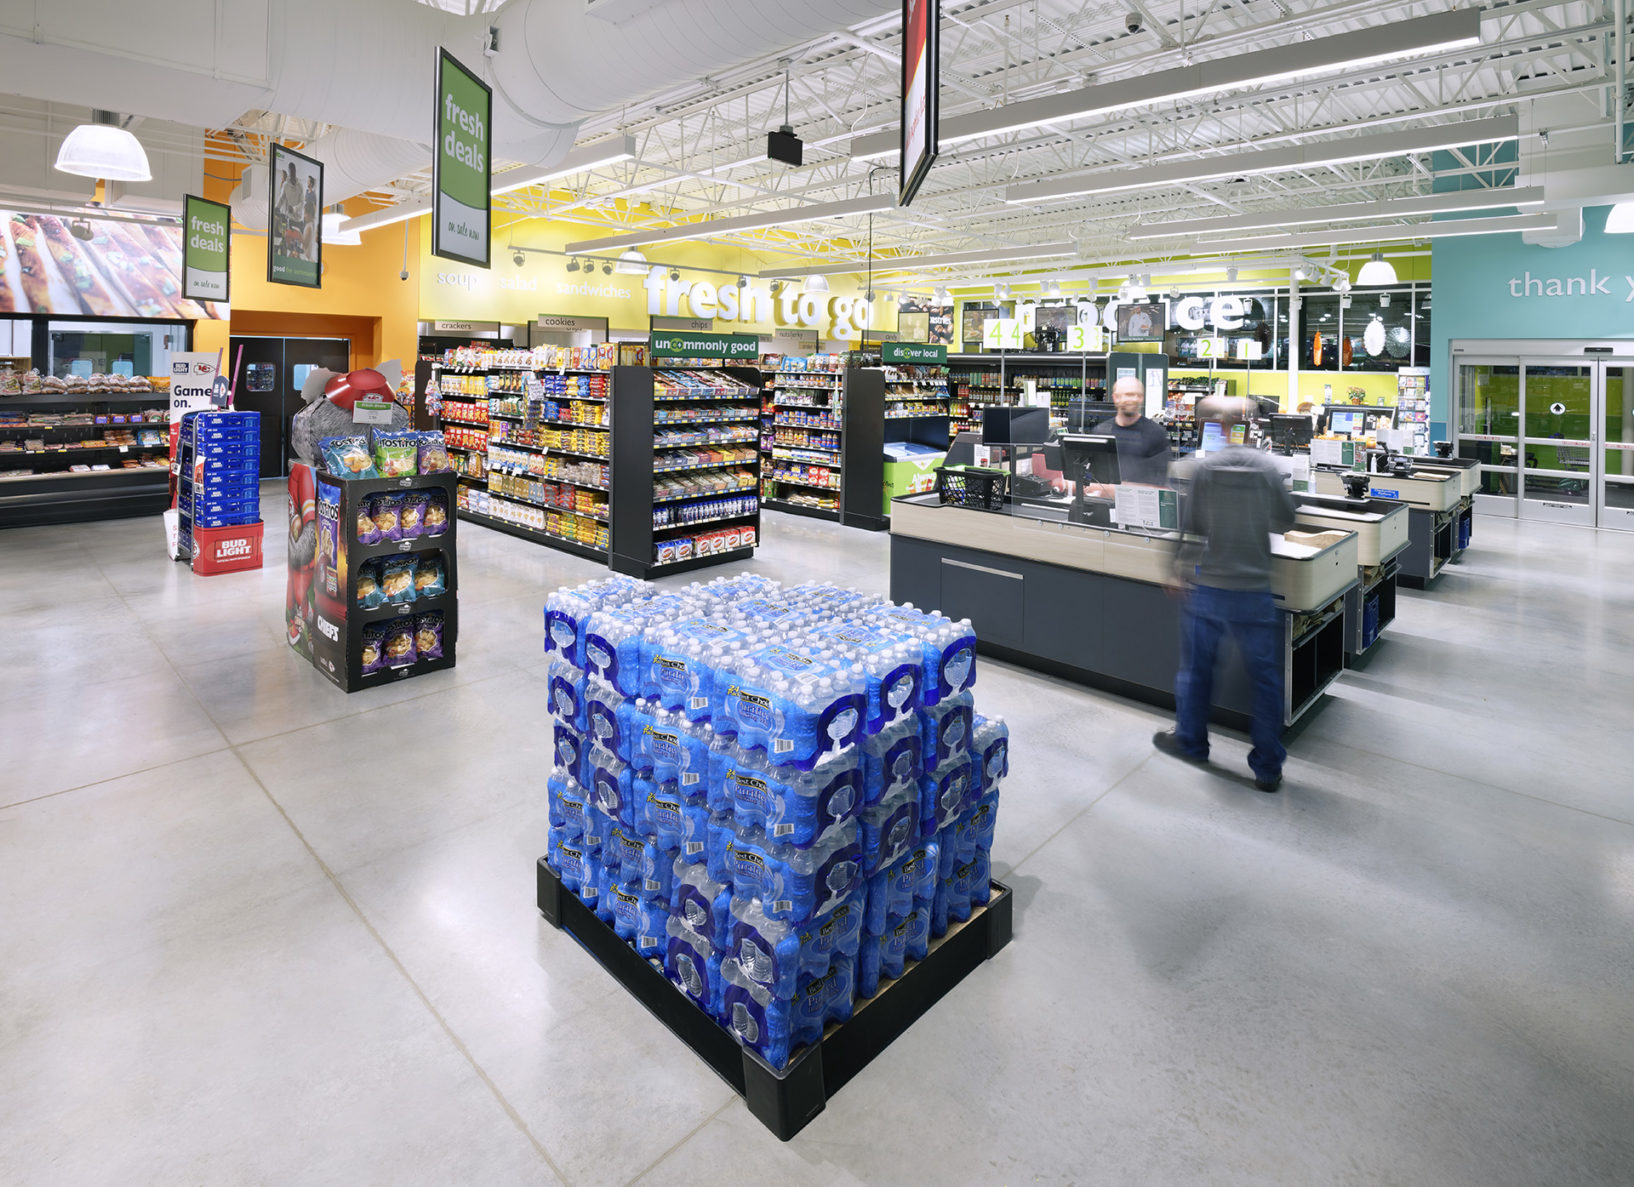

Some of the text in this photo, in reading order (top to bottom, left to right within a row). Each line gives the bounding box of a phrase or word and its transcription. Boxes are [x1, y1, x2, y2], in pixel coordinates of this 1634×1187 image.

[445, 93, 484, 142] fresh
[444, 130, 484, 173] deals
[190, 215, 225, 236] fresh
[457, 221, 468, 237] sale
[190, 234, 225, 253] deals
[272, 265, 286, 273] good
[436, 272, 478, 292] soup
[499, 274, 538, 292] salad
[556, 280, 632, 300] sandwiches
[1508, 268, 1612, 298] thank
[642, 264, 874, 341] fresh to go
[441, 322, 472, 330] crackers
[545, 317, 576, 327] cookies
[691, 320, 709, 329] chips
[988, 320, 1003, 346] 4
[1011, 321, 1021, 347] 4
[1073, 327, 1085, 349] 3
[730, 341, 756, 354] good
[922, 348, 938, 358] local
[1201, 339, 1212, 356] 2
[174, 385, 212, 397] Game
[173, 399, 192, 408] on.
[216, 544, 252, 558] LIGHT
[221, 538, 247, 549] BUD
[317, 614, 339, 643] CHIEFS
